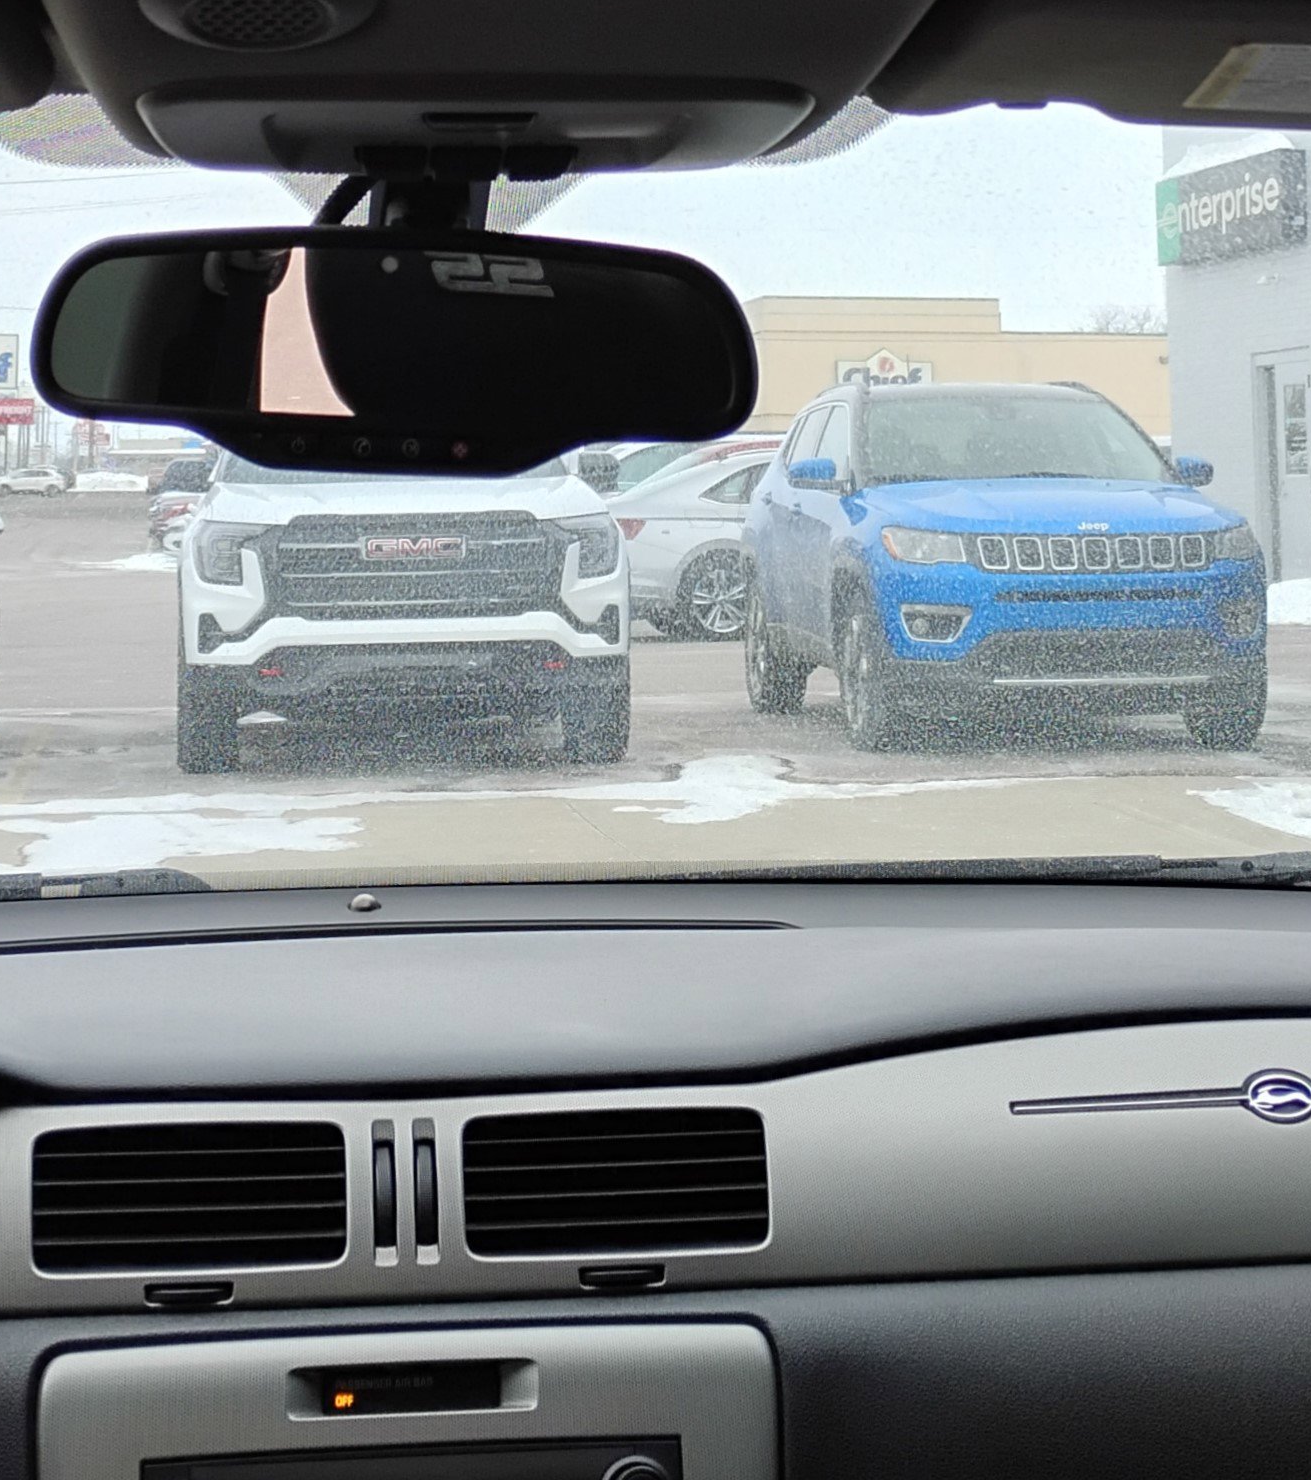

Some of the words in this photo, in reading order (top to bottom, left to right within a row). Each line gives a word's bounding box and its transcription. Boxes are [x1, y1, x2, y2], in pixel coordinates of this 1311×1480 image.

[1157, 173, 1280, 239] enterprise
[1077, 522, 1109, 531] Jeep
[367, 538, 462, 558] GMC
[334, 1393, 355, 1408] OFF
